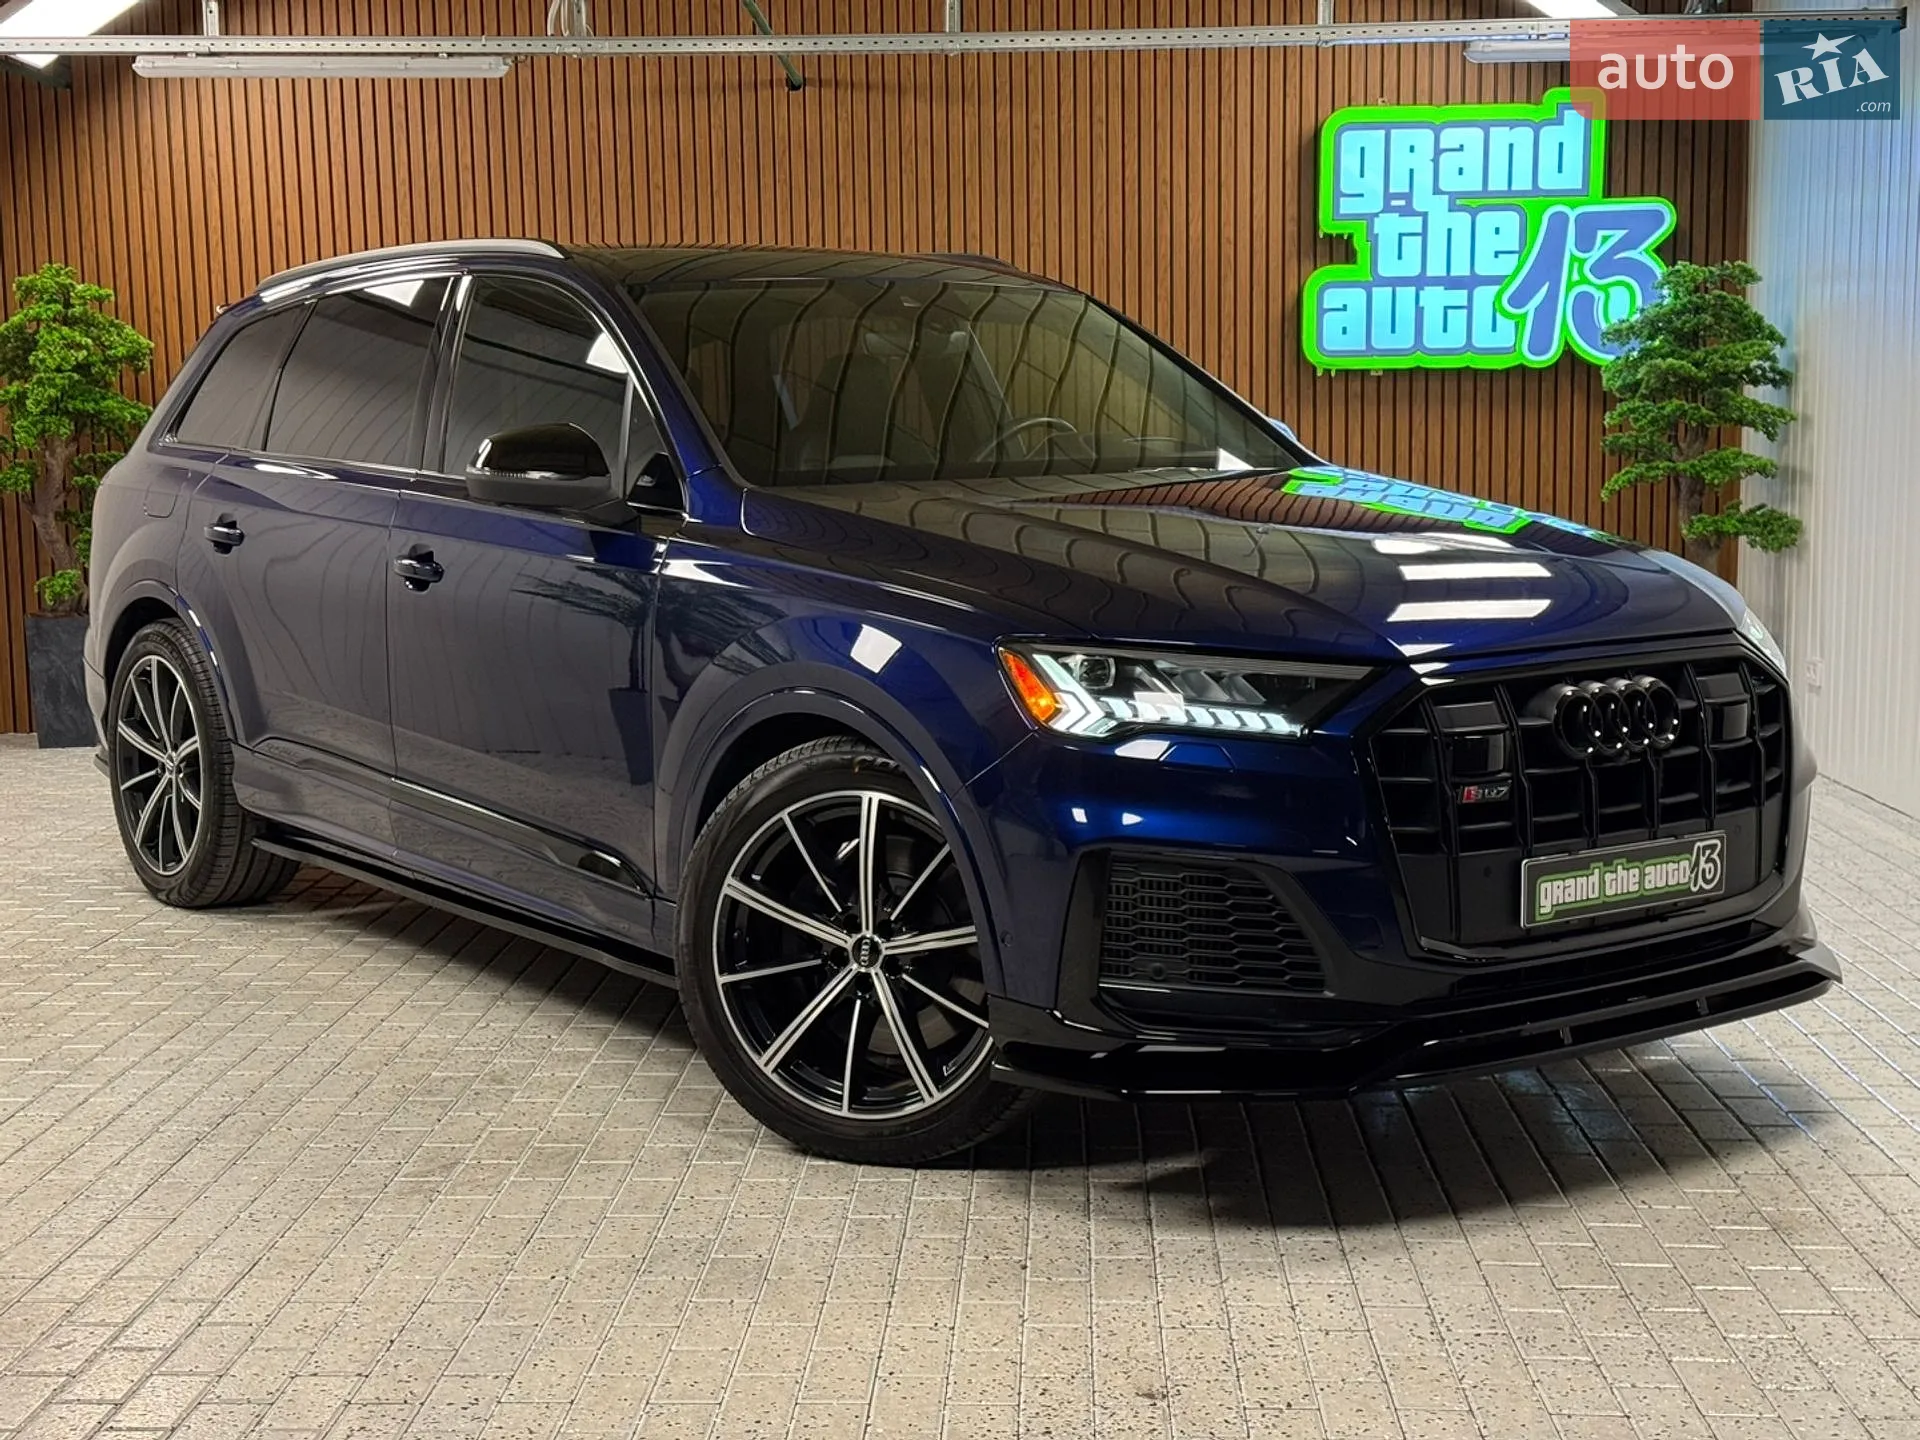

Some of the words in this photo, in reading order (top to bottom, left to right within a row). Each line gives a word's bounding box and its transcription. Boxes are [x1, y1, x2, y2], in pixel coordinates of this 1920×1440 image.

[1374, 196, 1520, 277] the
[1322, 285, 1516, 352] auto
[1502, 203, 1674, 362] 13
[1604, 865, 1639, 896] the
[1644, 859, 1690, 889] auto
[1689, 839, 1721, 892] 13
